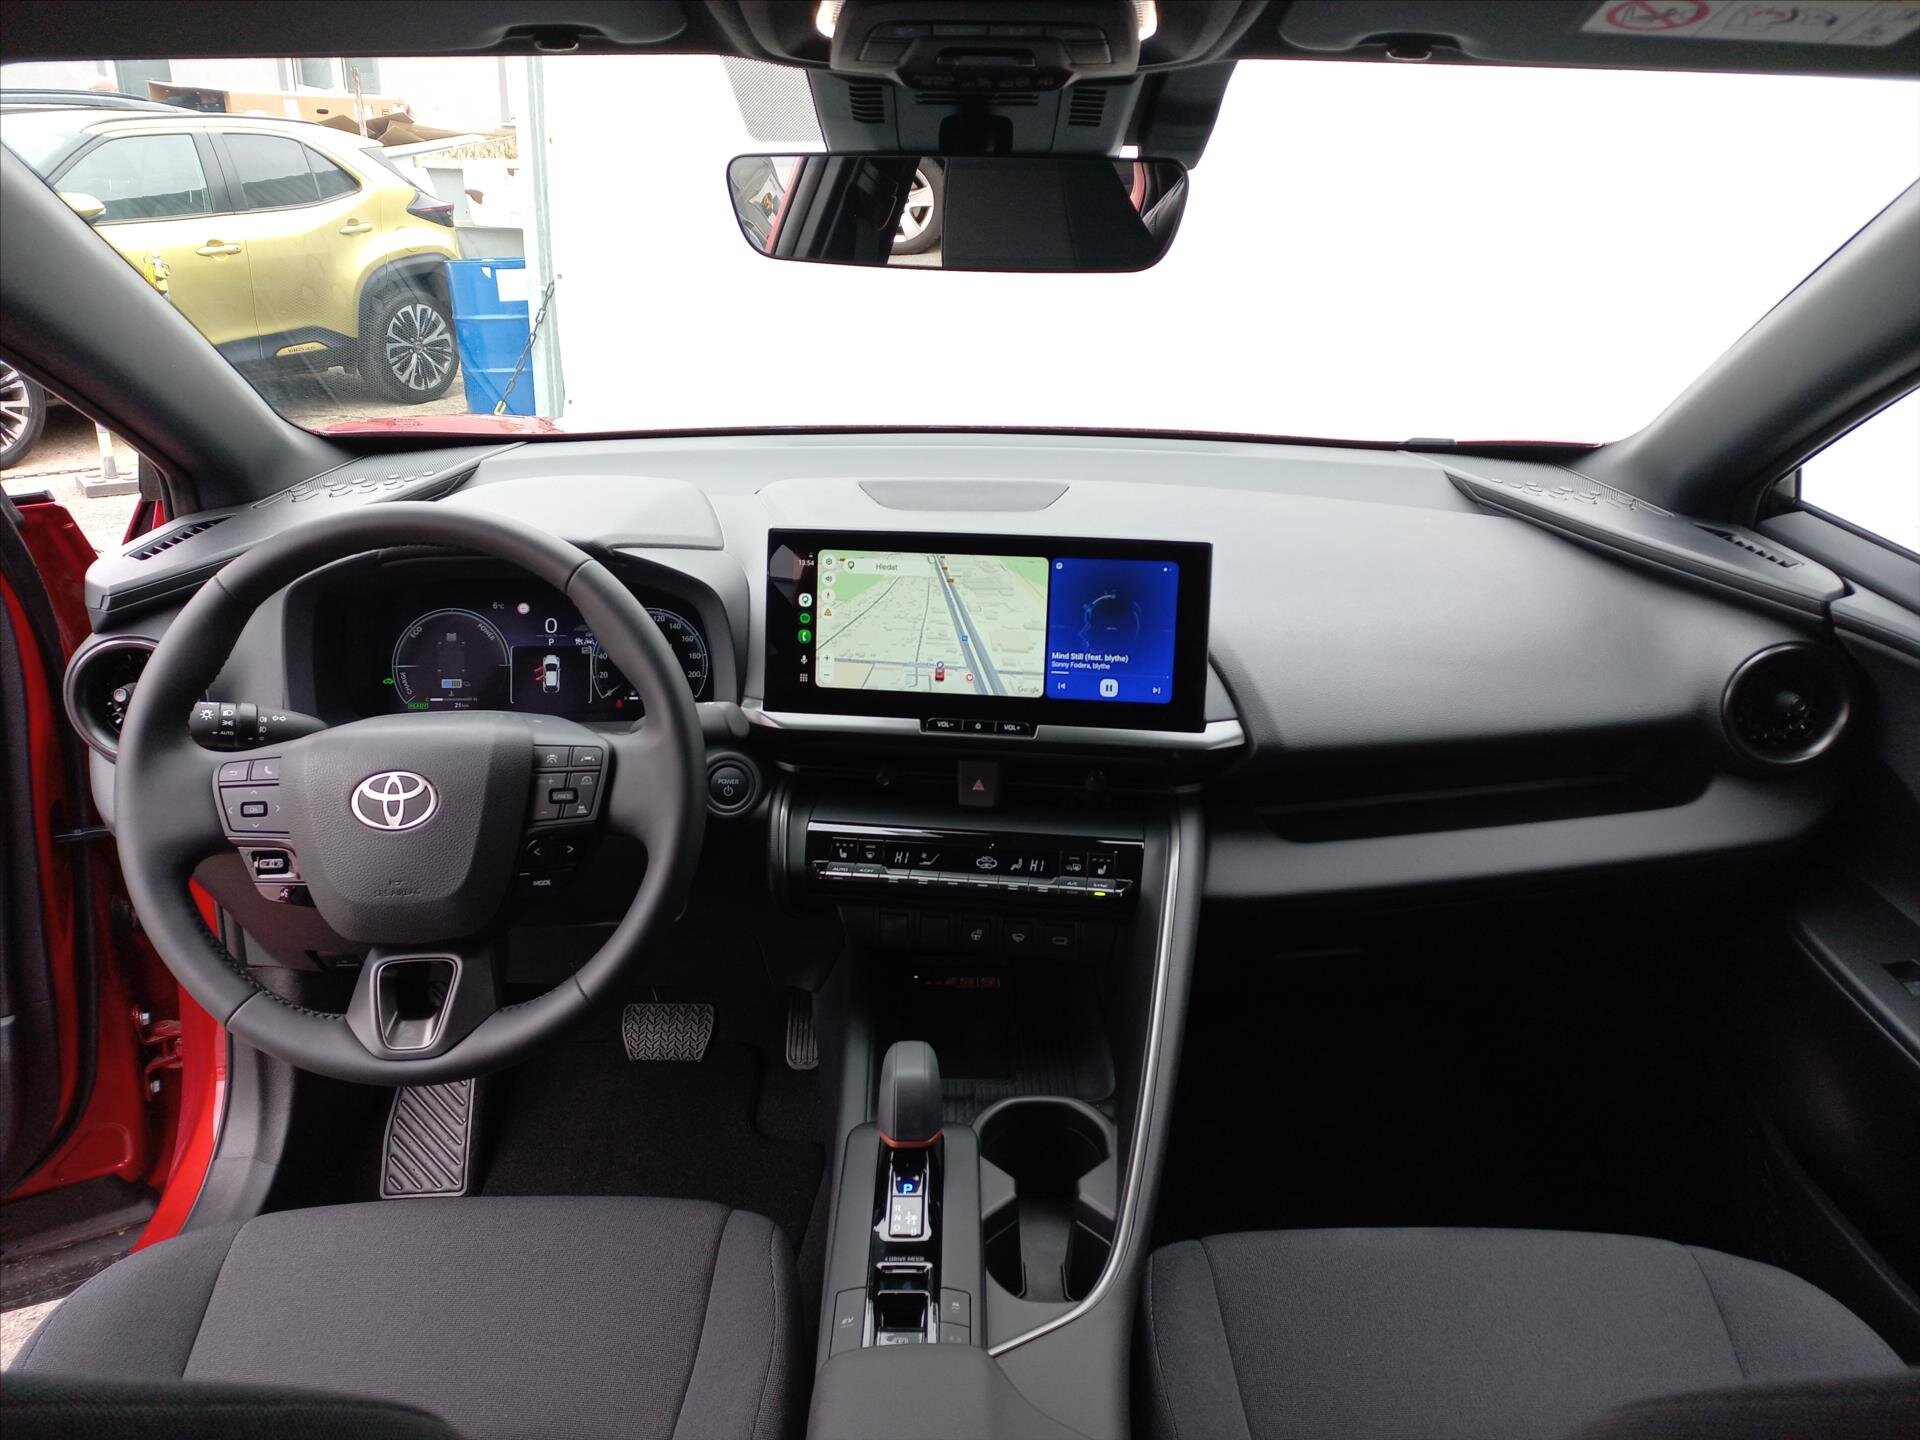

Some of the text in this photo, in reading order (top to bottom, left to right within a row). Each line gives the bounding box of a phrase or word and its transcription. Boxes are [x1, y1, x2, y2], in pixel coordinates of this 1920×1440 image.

[545, 617, 558, 634] 0
[410, 626, 423, 639] ECO
[477, 623, 495, 641] POWER
[548, 638, 554, 646] P
[1051, 652, 1129, 663] Mind Still (feat. blythe)
[1051, 661, 1110, 671] Sonny Fodera, blythe
[903, 1183, 913, 1195] P
